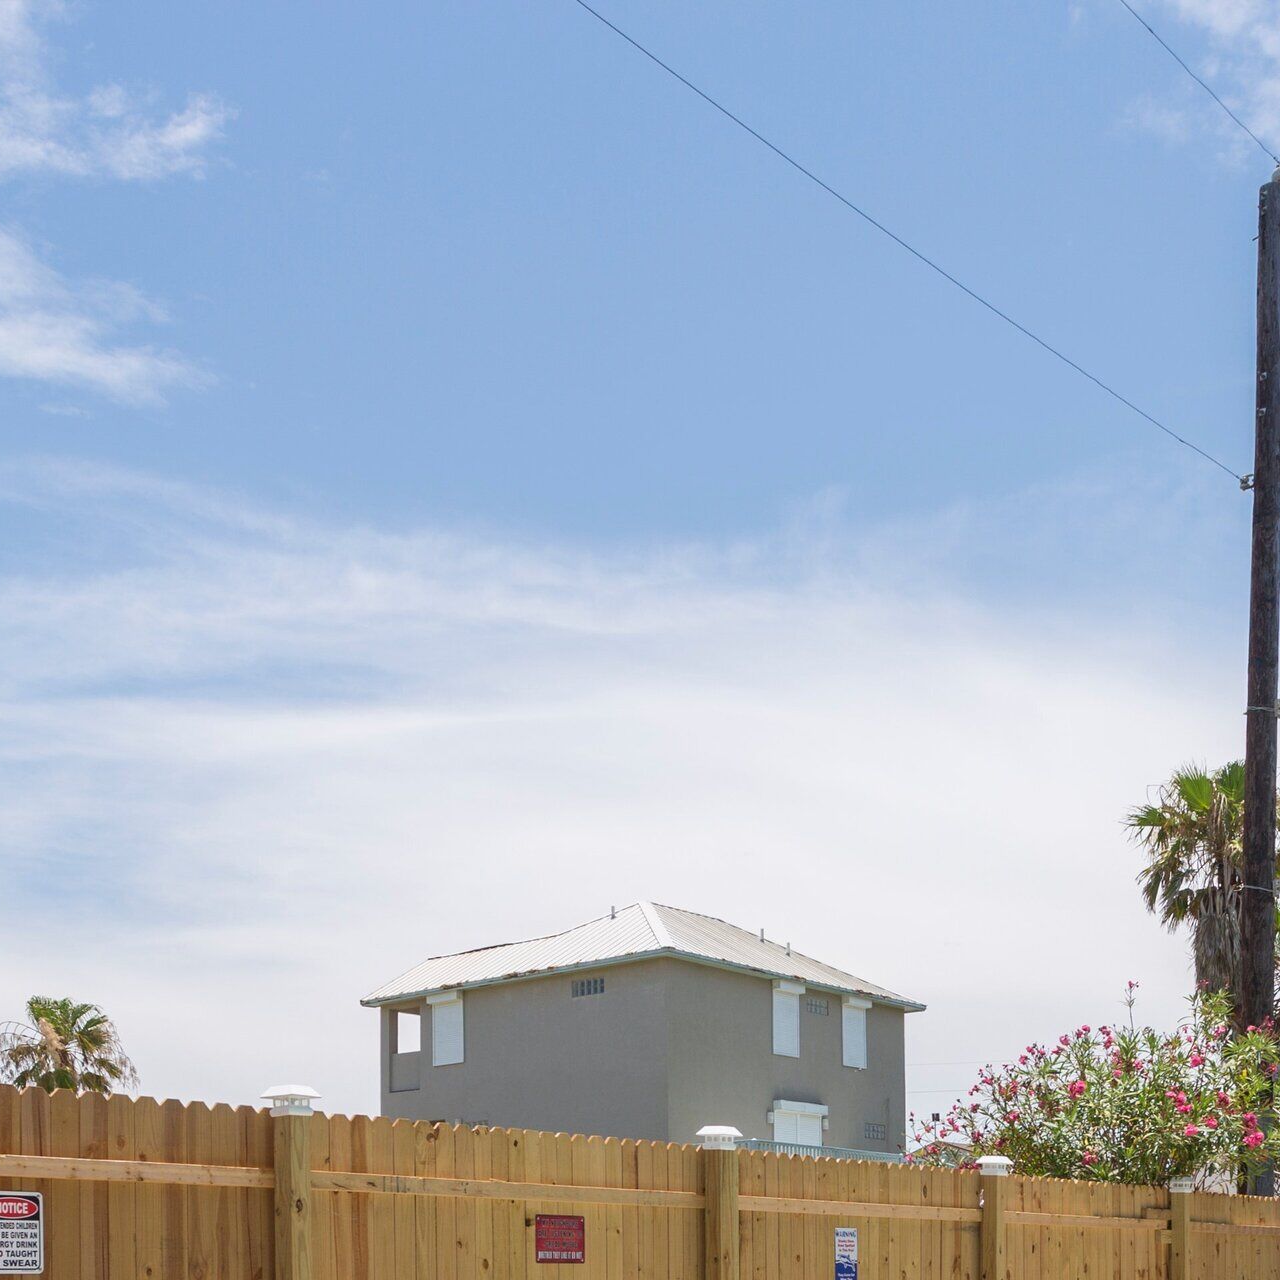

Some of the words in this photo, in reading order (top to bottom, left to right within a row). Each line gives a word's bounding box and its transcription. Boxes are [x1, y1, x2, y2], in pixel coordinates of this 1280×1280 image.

[15, 1222, 38, 1230] CHILDREN
[1, 1231, 9, 1239] BE
[10, 1231, 28, 1239] GIVEN
[29, 1231, 38, 1239] AN
[16, 1240, 38, 1249] DRINK
[5, 1250, 38, 1258] TAUGHT
[2, 1259, 38, 1267] SWEAR
